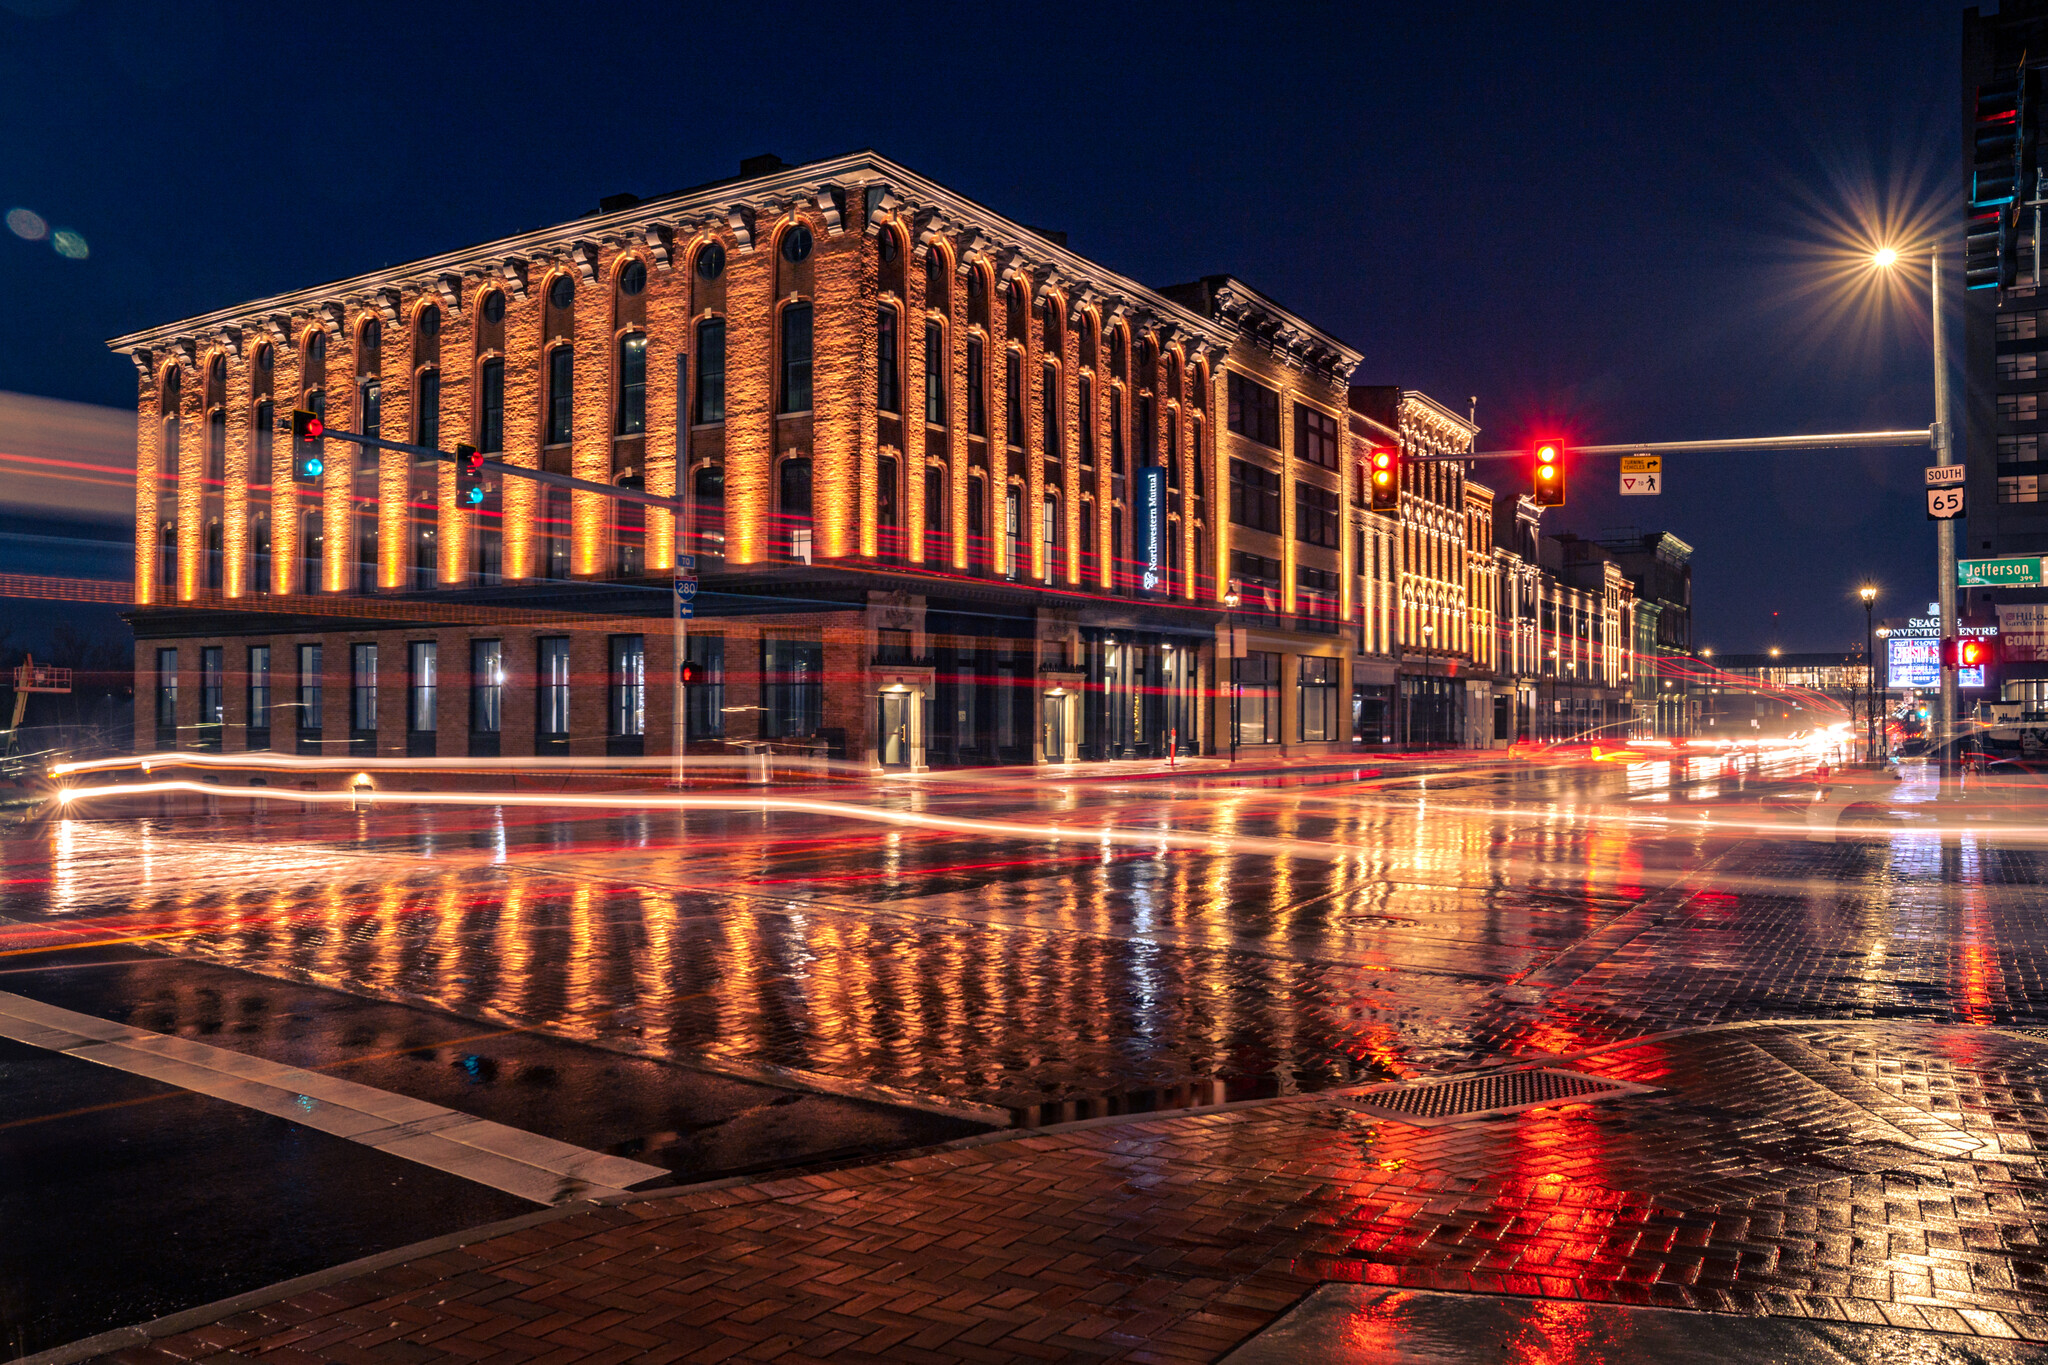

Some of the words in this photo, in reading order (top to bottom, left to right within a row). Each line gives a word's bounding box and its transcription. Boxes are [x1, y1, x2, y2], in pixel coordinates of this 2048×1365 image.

[1928, 469, 1962, 480] SOUTH
[1148, 473, 1158, 507] Mutual
[1933, 494, 1958, 510] 65
[1148, 507, 1158, 571] Northwestern
[681, 557, 690, 565] TO
[1966, 563, 2029, 577] Jefferson
[678, 582, 695, 594] 280
[1959, 627, 1998, 636] ENTRE
